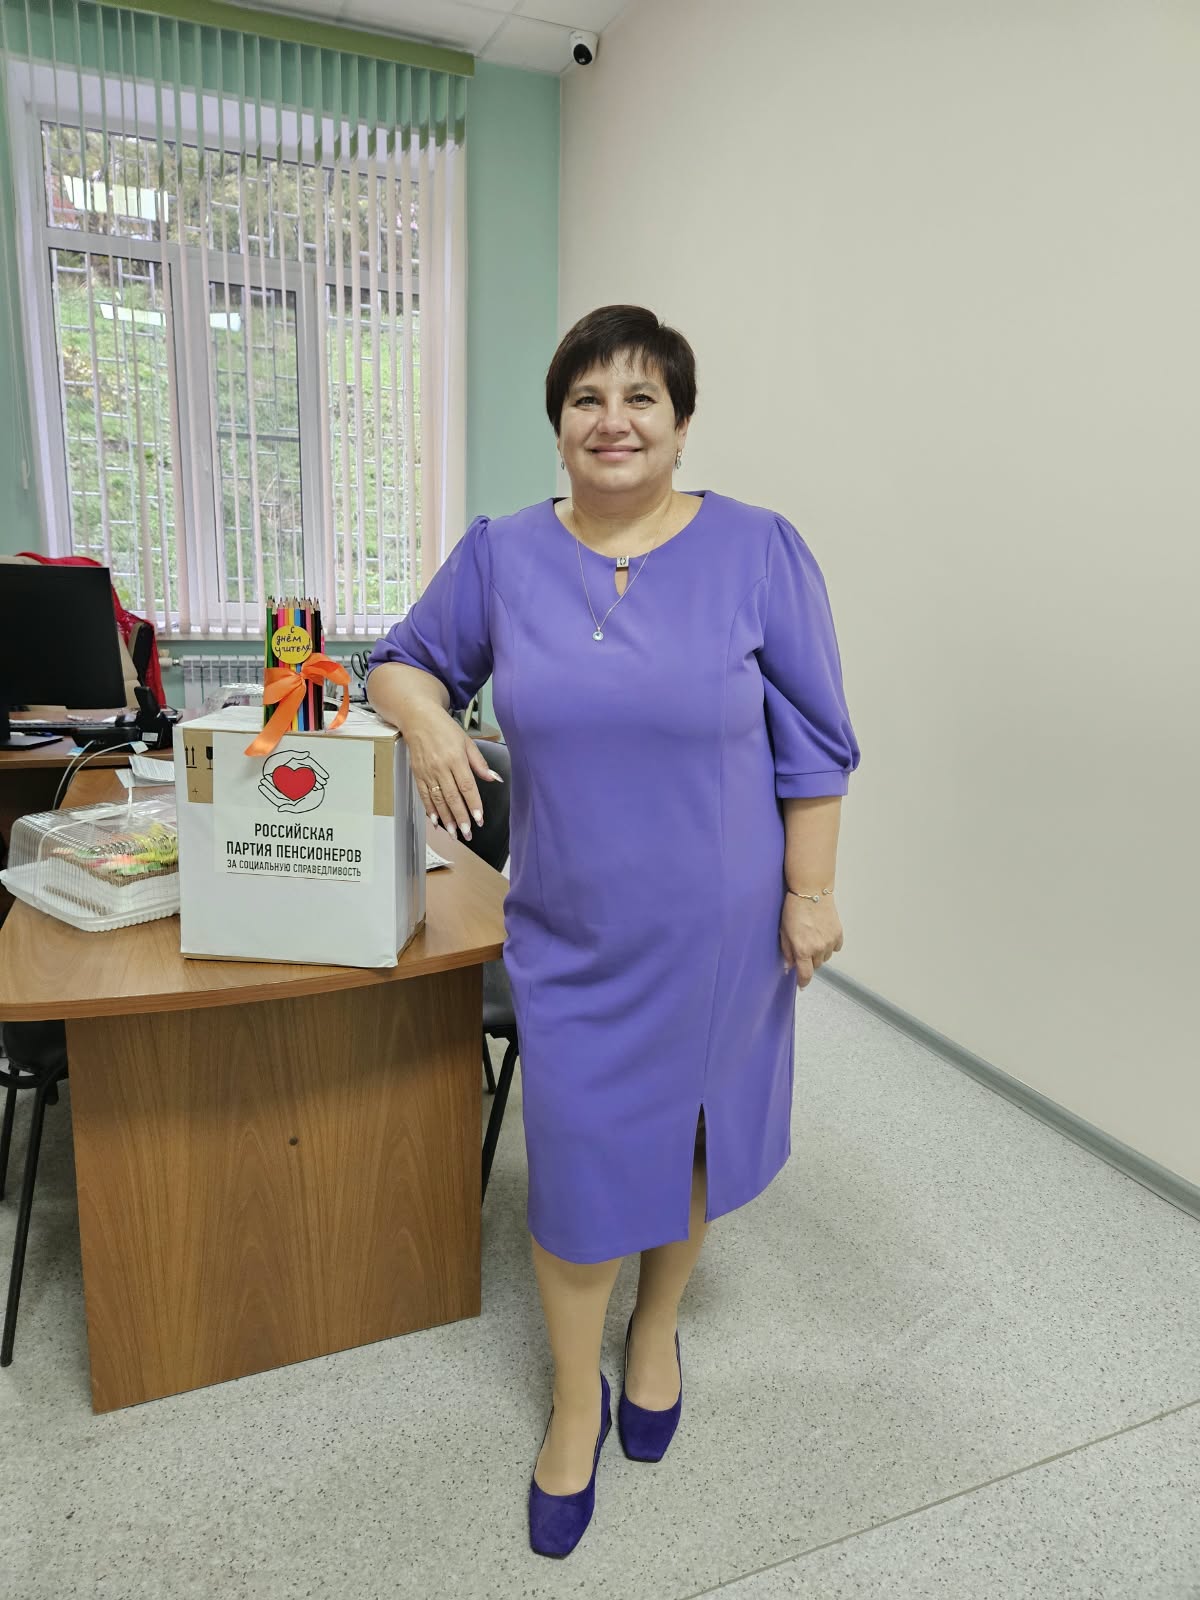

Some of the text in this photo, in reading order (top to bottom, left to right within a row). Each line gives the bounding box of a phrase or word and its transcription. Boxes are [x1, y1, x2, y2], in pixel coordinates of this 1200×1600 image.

[254, 822, 334, 842] РОССИЙСКАЯ
[226, 841, 362, 863] ПАРТИЯ ПЕНСИОНЕРОВ
[227, 859, 362, 877] ЗА СОЦИАЛЬНУЮ СПРАВЕДЛИВОСТЬ
